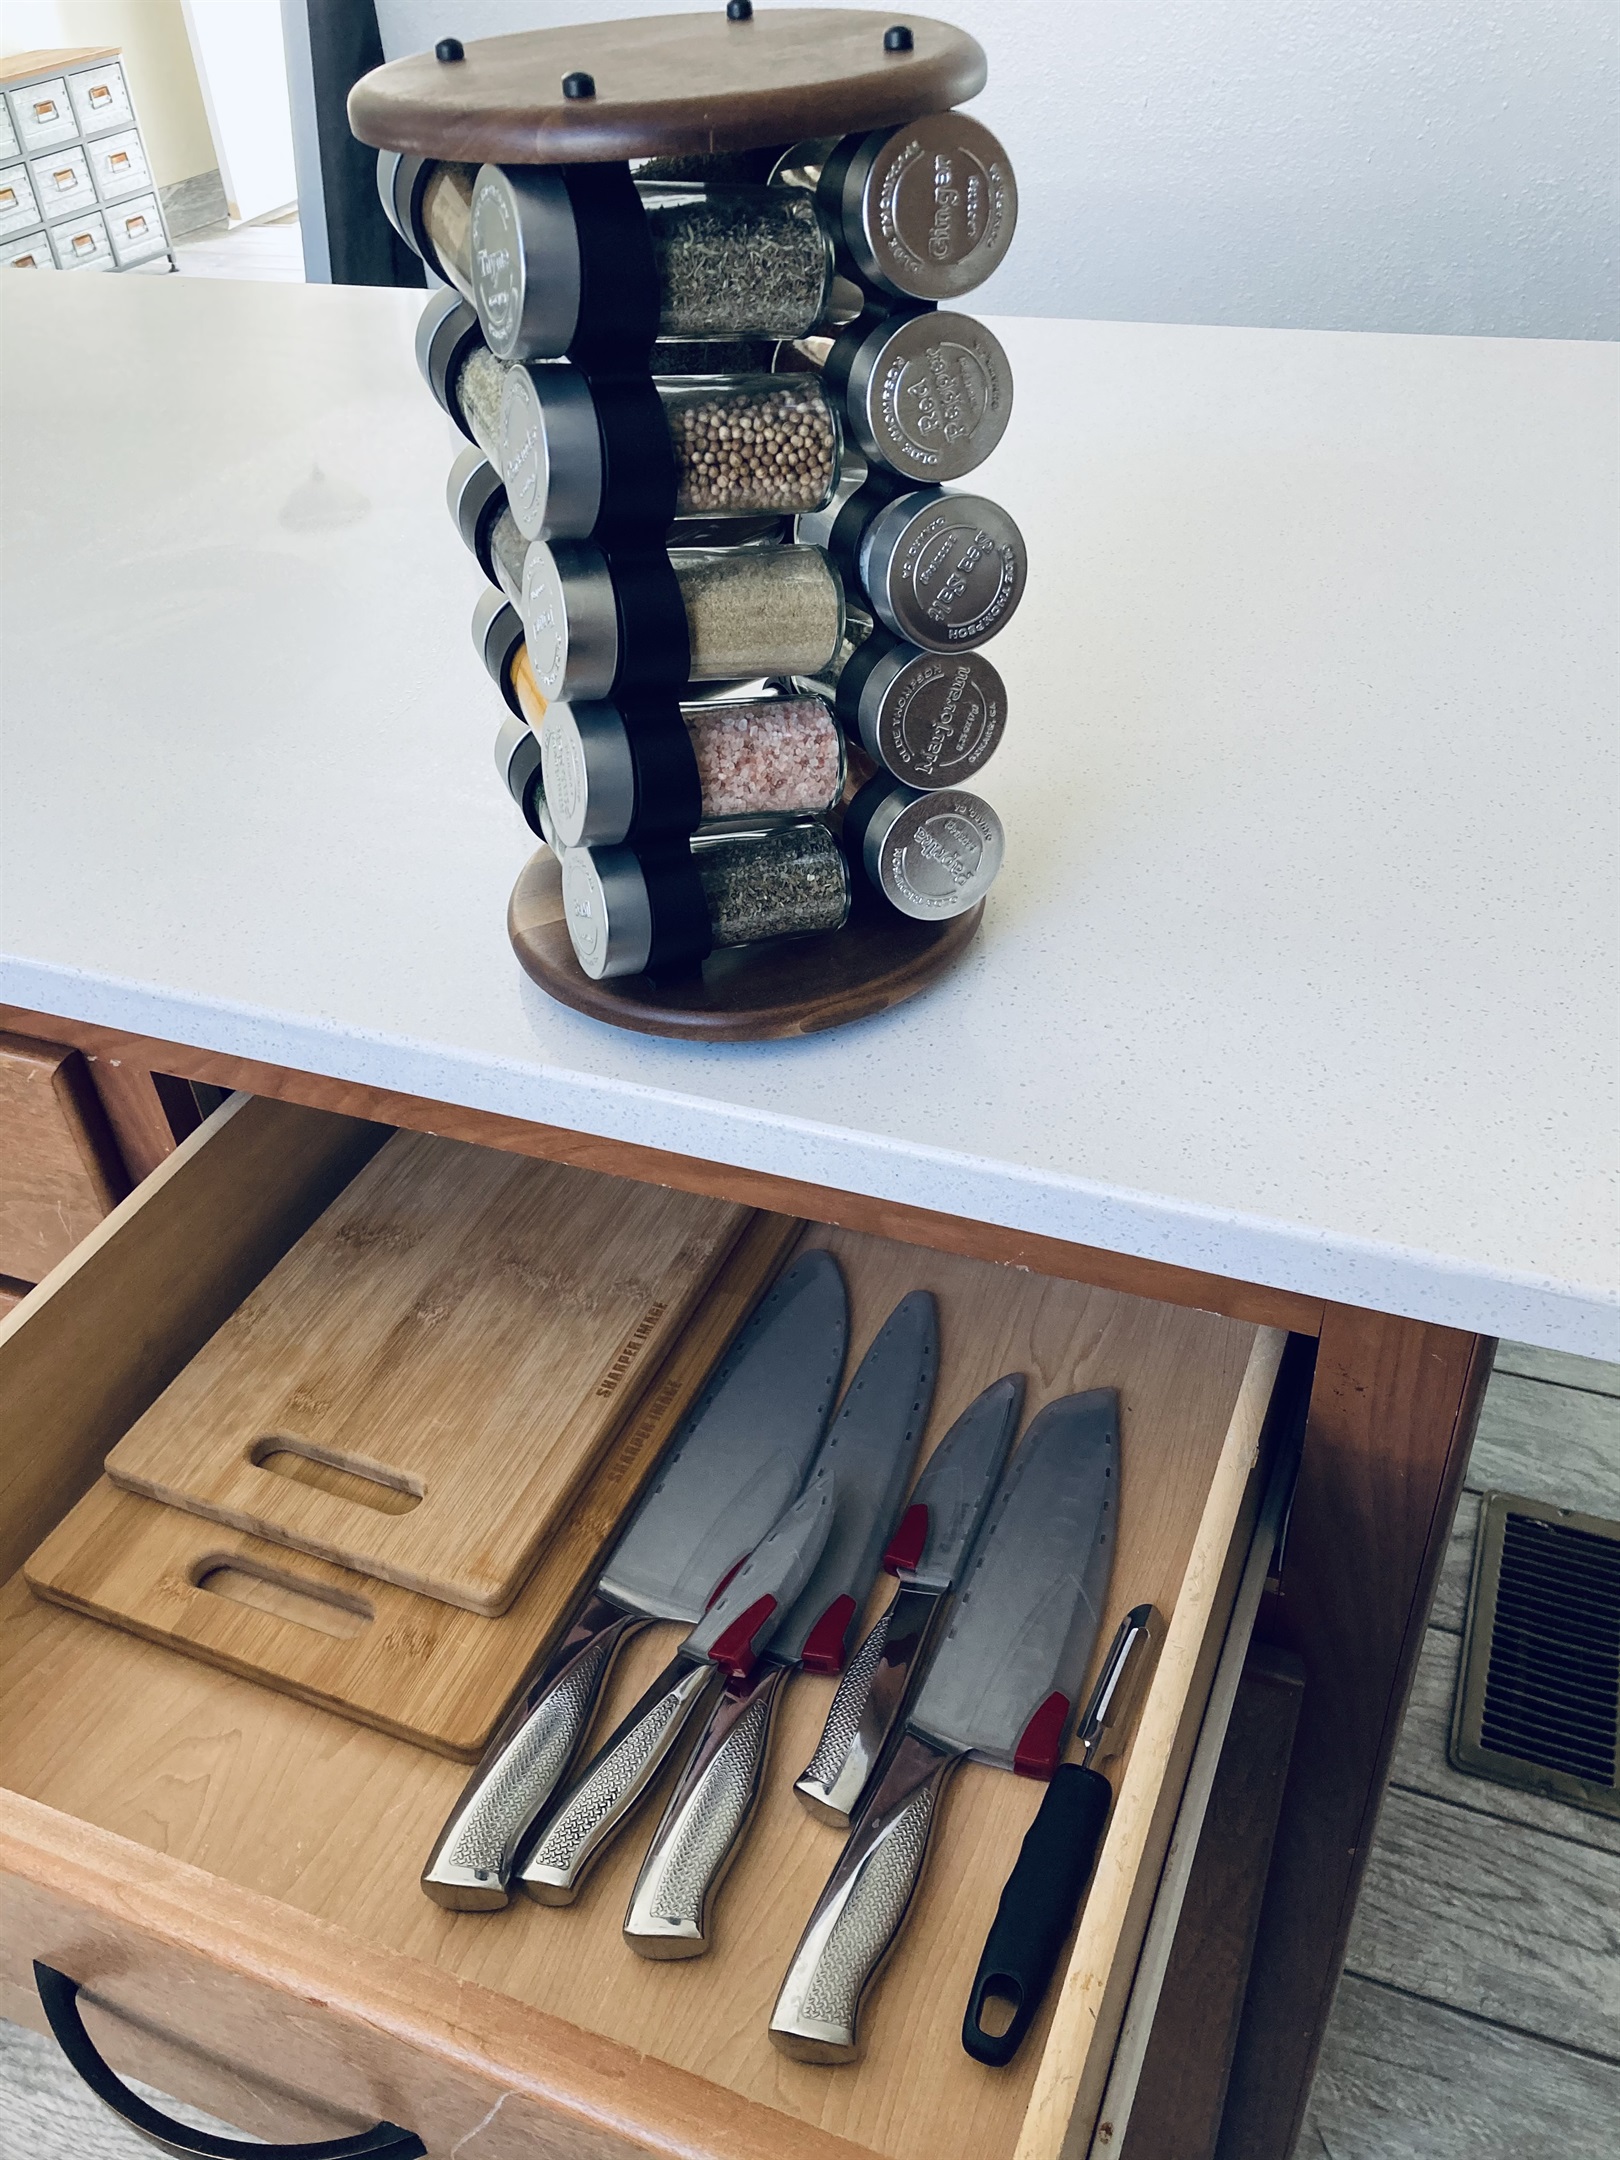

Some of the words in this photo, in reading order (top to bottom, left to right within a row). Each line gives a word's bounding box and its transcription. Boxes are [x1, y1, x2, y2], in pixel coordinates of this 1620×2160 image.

[929, 154, 960, 261] Ginger
[907, 377, 942, 437] Red
[925, 347, 970, 443] Pepper
[956, 529, 996, 574] Sea
[926, 571, 967, 622] Salt
[948, 587, 1012, 640] THOMPSON
[892, 663, 943, 728] THOMPSON
[914, 665, 972, 776] Marjoram
[892, 730, 912, 764] OLDE
[913, 825, 975, 887] Paprika
[596, 1340, 641, 1398] SHARPER
[634, 1300, 669, 1340] IMAGE
[608, 1421, 656, 1484] SHARPER
[648, 1378, 683, 1422] IMAGE
